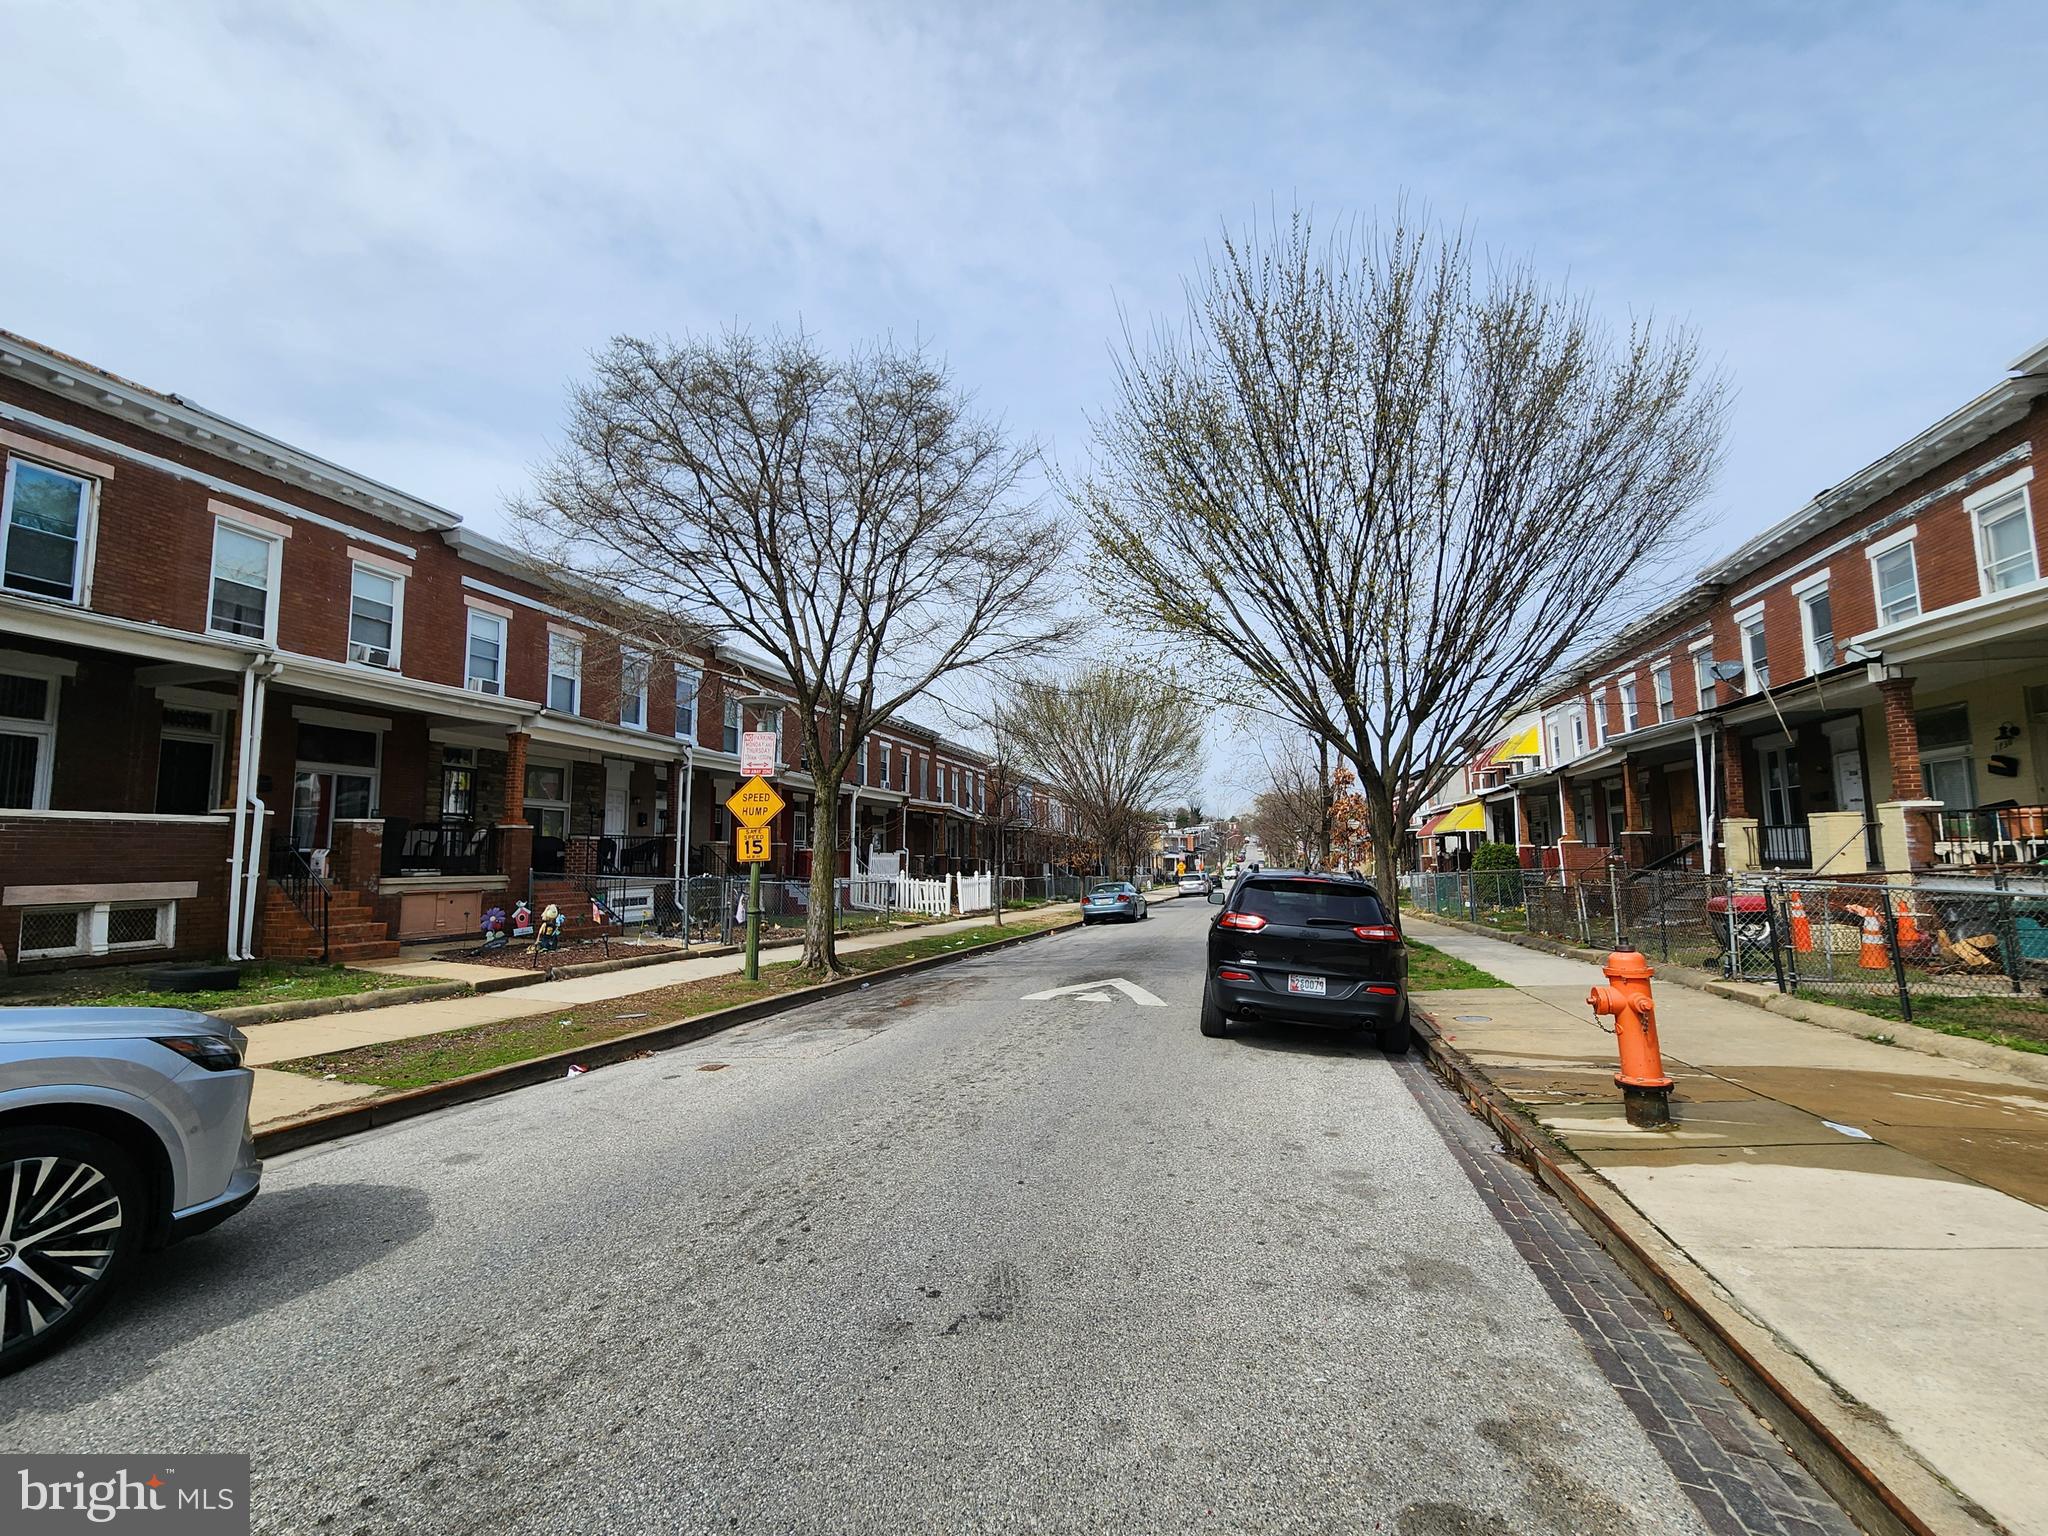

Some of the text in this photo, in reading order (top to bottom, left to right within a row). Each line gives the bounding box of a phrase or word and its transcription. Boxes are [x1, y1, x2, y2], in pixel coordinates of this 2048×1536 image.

[742, 793, 770, 802] SPEED
[742, 807, 769, 816] HUMP
[744, 840, 763, 854] 15
